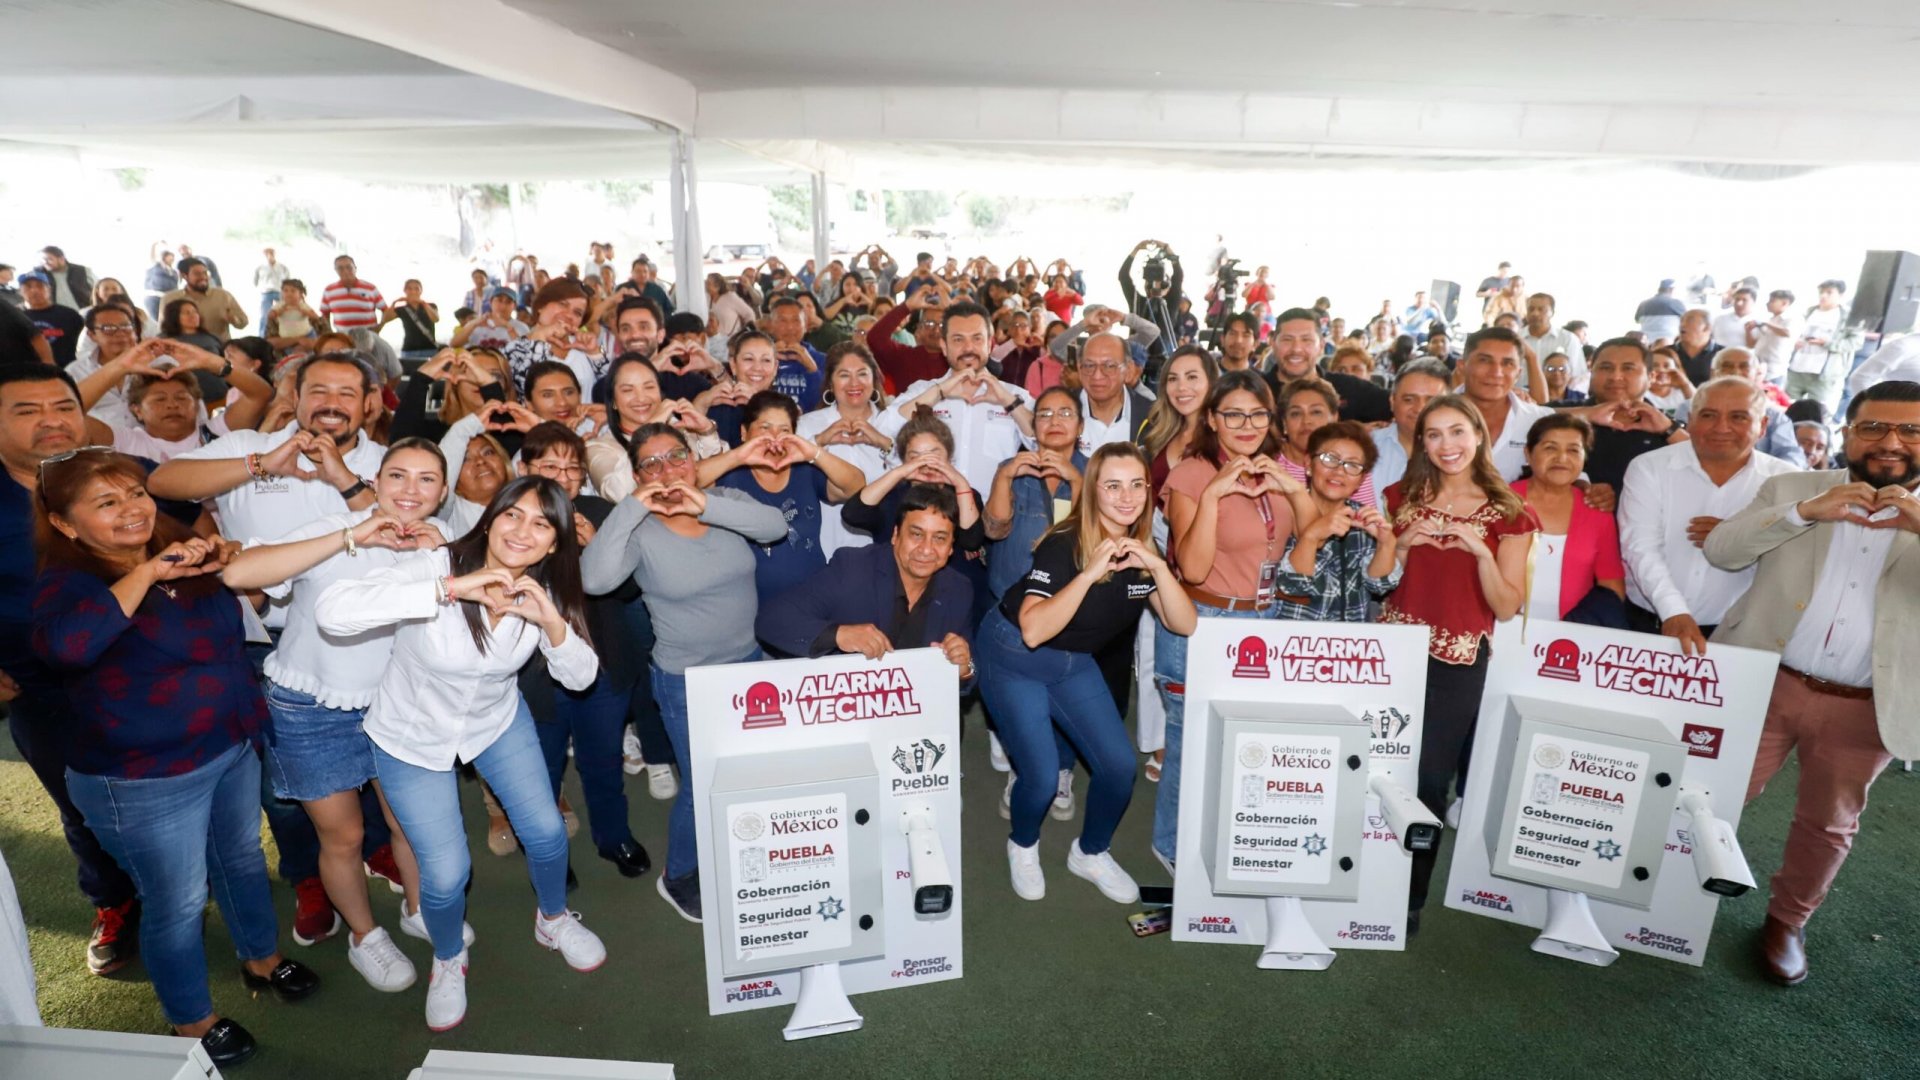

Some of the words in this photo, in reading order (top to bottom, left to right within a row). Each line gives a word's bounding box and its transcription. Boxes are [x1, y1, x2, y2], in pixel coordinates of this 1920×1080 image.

[1281, 635, 1386, 661] ALARMA
[1282, 658, 1391, 685] VECINAL
[1595, 644, 1719, 683] ALARMA
[797, 667, 912, 699] ALARMA
[1595, 663, 1723, 707] VECINAL
[797, 690, 921, 725] VECINAL
[1272, 745, 1318, 754] Gobierno
[1320, 747, 1332, 755] de
[1369, 741, 1411, 755] uebla
[1271, 754, 1331, 769] México
[1571, 750, 1623, 766] Gobierno
[1626, 760, 1639, 769] de
[1569, 758, 1636, 781] México
[892, 773, 949, 791] Puebla
[1266, 780, 1324, 793] PUEBLA
[1560, 782, 1624, 803] PUEBLA
[770, 808, 823, 820] Gobierno
[825, 806, 838, 814] de
[1235, 812, 1317, 825] Gobernación
[1523, 805, 1613, 832] Gobernación
[771, 816, 839, 836] México
[1234, 835, 1298, 848] Seguridad
[1373, 830, 1382, 839] la
[1385, 831, 1397, 841] pa
[1519, 826, 1589, 848] Seguridad
[768, 843, 834, 861] PUEBLA
[1515, 845, 1581, 867] Bienestar
[1680, 844, 1692, 855] la
[1232, 856, 1293, 869] Bienestar
[896, 870, 911, 879] Po
[737, 879, 830, 899] Gobernación
[1462, 894, 1513, 912] PUEBLA
[738, 905, 812, 924] Seguridad
[1188, 923, 1237, 934] PUEBLA
[1349, 921, 1391, 932] Pensar
[1350, 930, 1396, 941] Grande
[740, 930, 808, 946] Bienestar
[1639, 927, 1688, 945] Pensar
[1640, 936, 1693, 956] Grande
[903, 956, 947, 969] Pensar
[904, 962, 953, 977] Grande
[740, 980, 773, 991] AMOR
[726, 987, 782, 1003] PUEBLA
